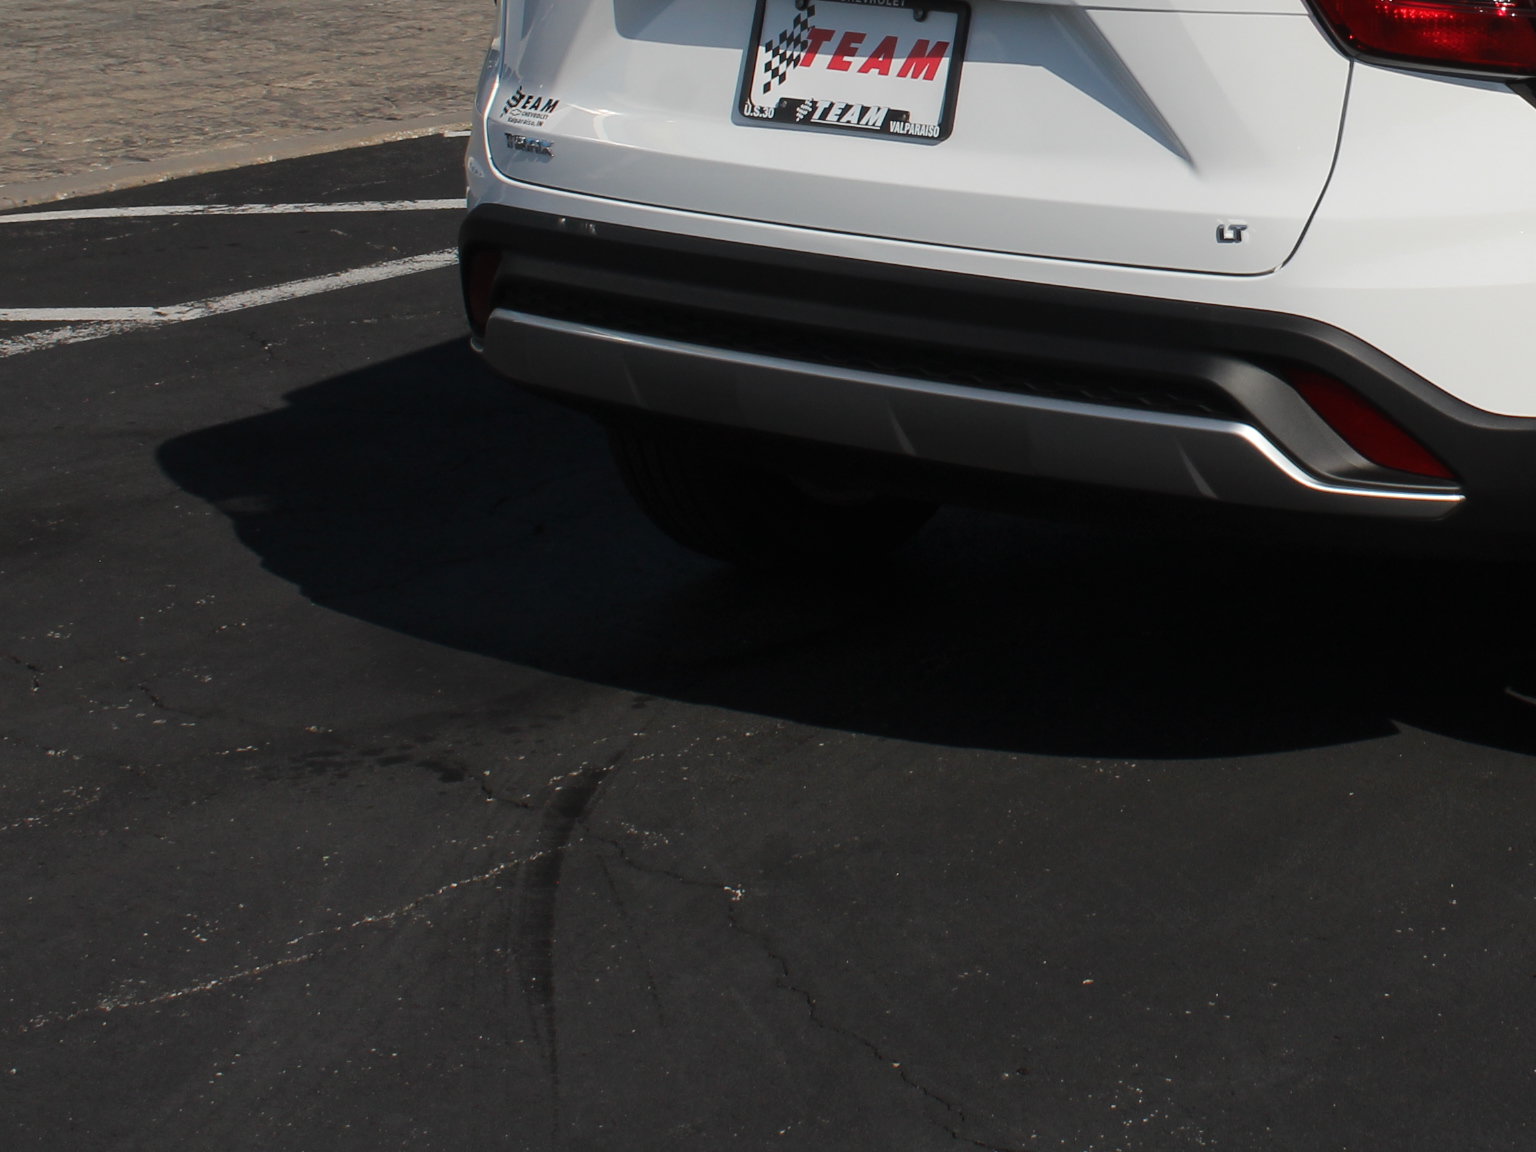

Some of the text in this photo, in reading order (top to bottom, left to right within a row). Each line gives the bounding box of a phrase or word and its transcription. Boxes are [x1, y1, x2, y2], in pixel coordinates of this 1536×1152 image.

[798, 28, 950, 81] TEAM
[810, 100, 890, 127] TEAM
[889, 120, 940, 138] VALPARAISO
[1215, 223, 1248, 244] LT
